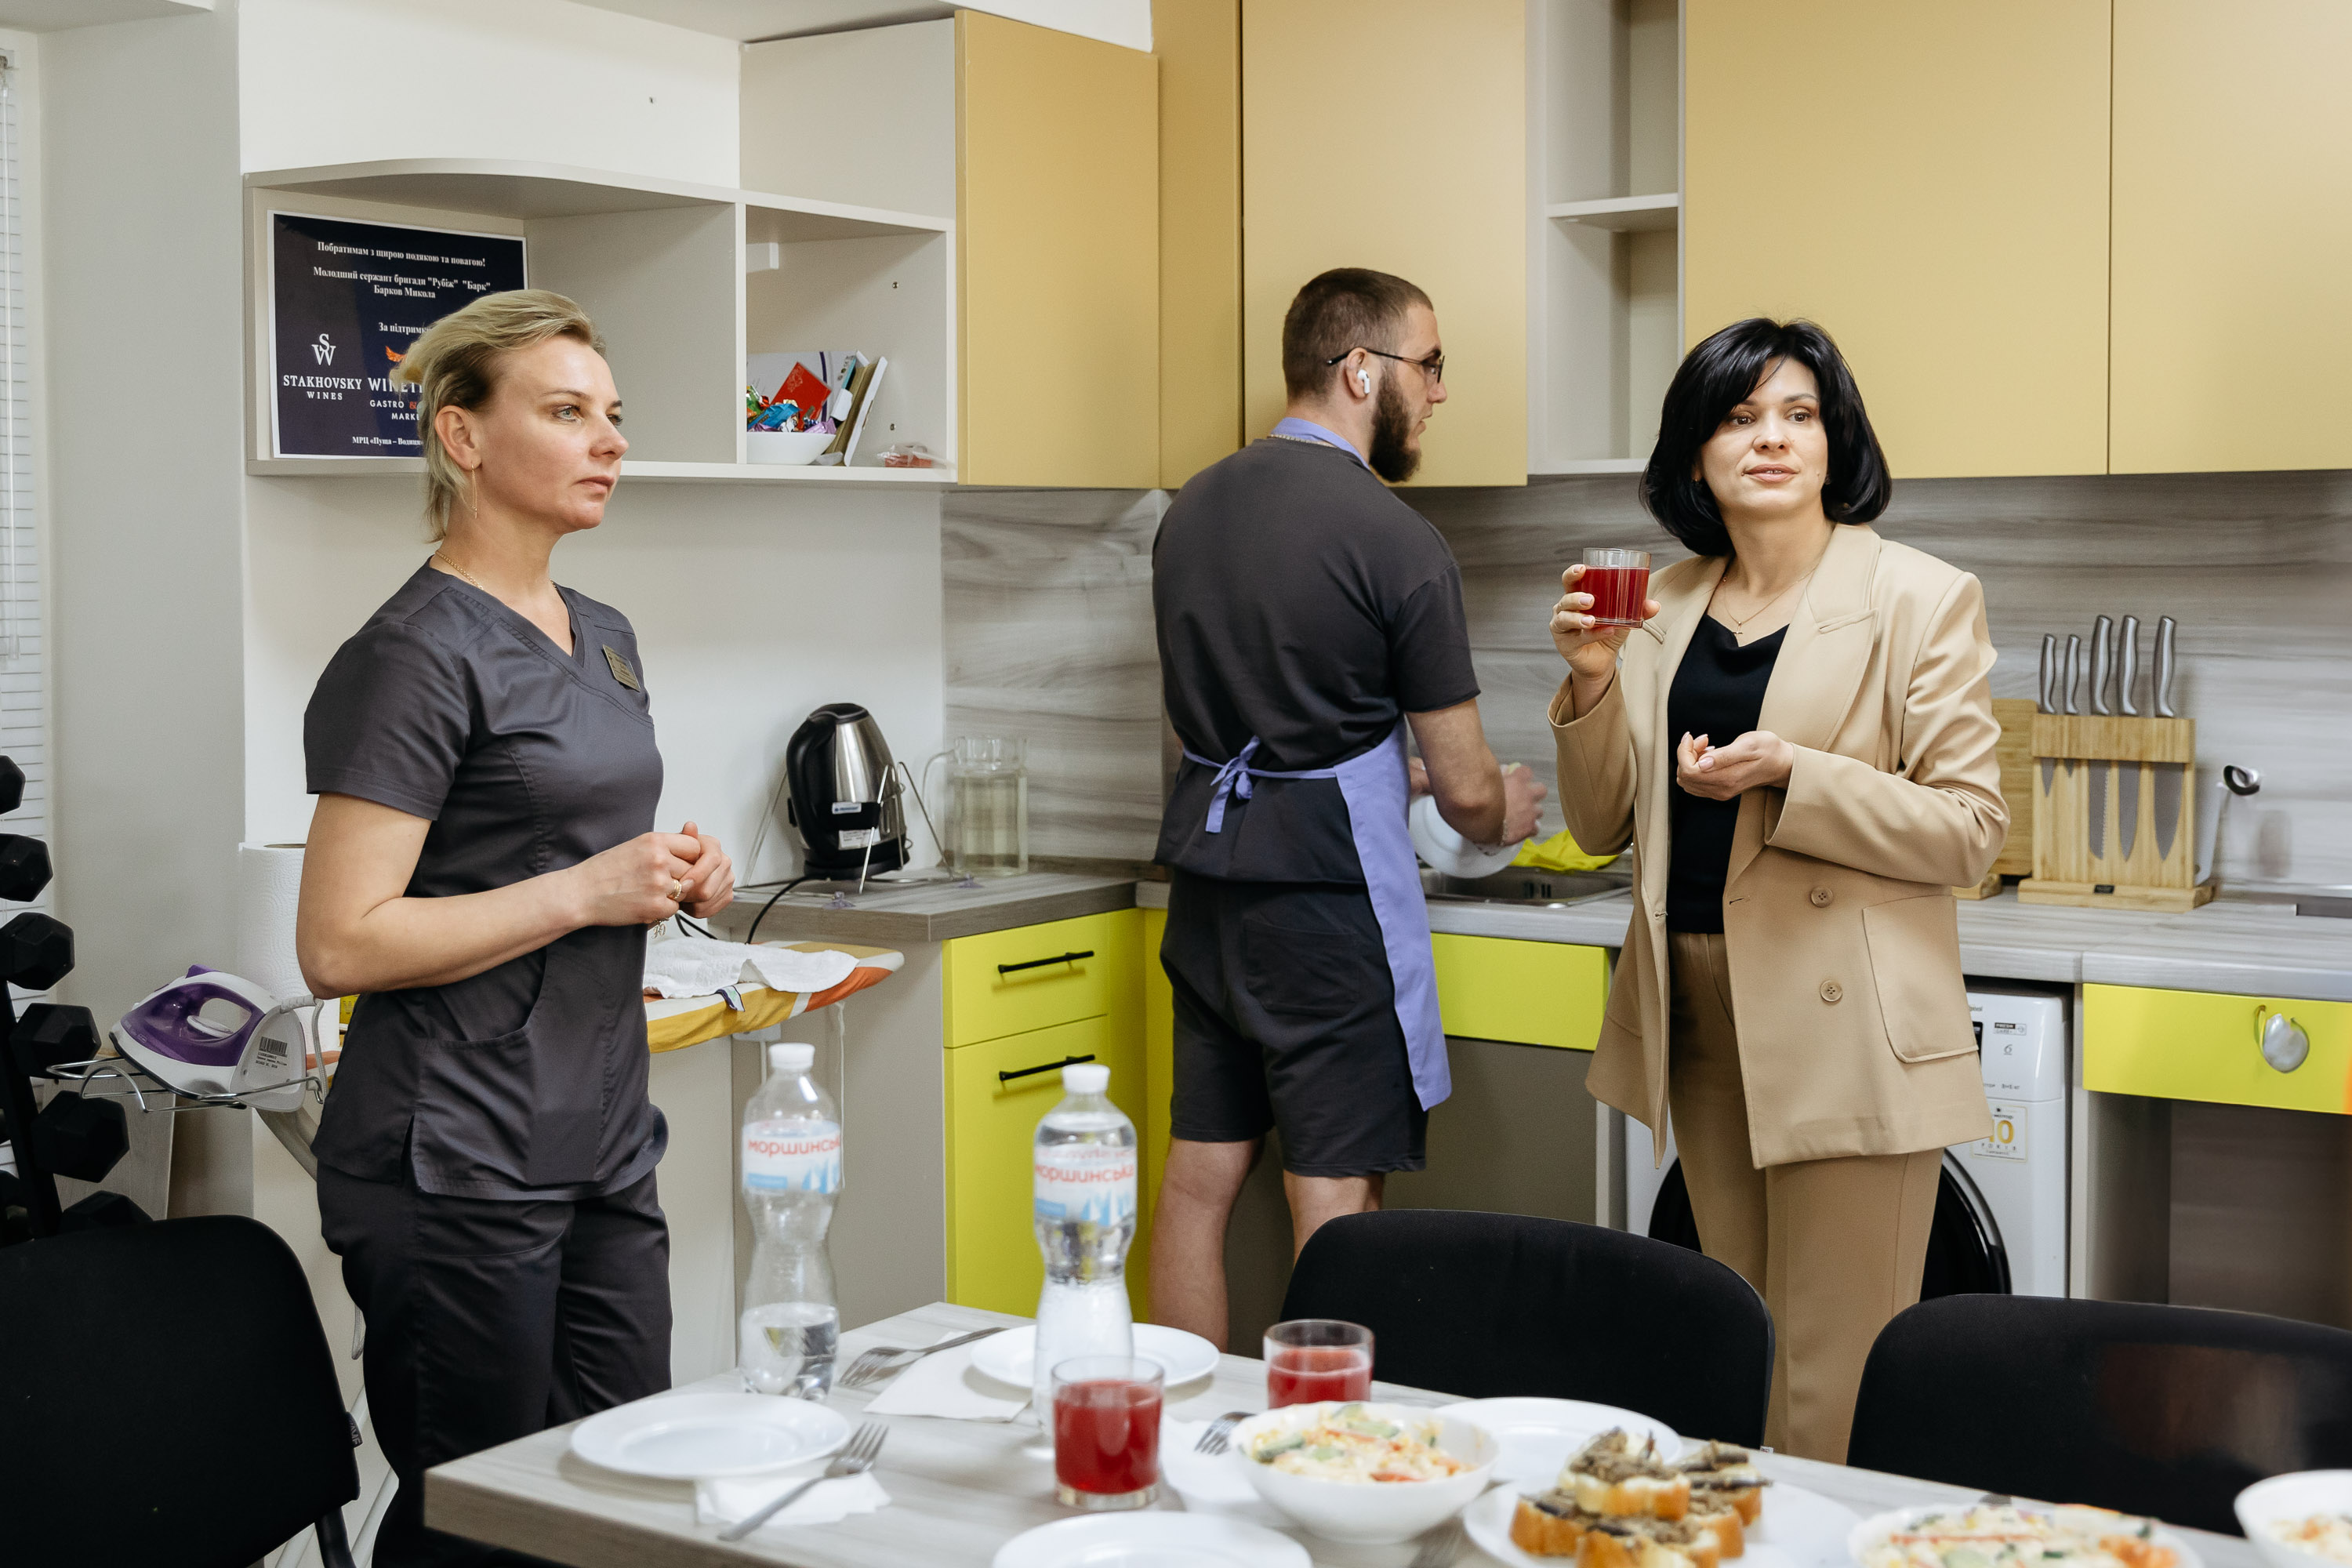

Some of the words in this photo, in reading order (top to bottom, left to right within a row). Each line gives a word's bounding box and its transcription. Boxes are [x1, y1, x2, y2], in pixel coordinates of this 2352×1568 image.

[318, 241, 368, 256] Побратимам
[376, 249, 405, 260] щирою
[405, 252, 439, 263] подякою
[451, 257, 486, 267] повагою!
[314, 267, 358, 280] Молодший
[360, 273, 392, 284] сержант
[394, 274, 426, 286] бригади
[428, 277, 459, 289] "Рубіж"
[463, 280, 491, 292] "Барк"
[374, 285, 403, 296] Барков
[405, 287, 436, 299] Микола
[379, 322, 389, 332] За
[390, 322, 430, 336] підтримк
[283, 374, 363, 390] STAKHOVSKY
[307, 390, 343, 401] WINES
[369, 400, 405, 408] GASTRO
[352, 436, 369, 445] МРЦ
